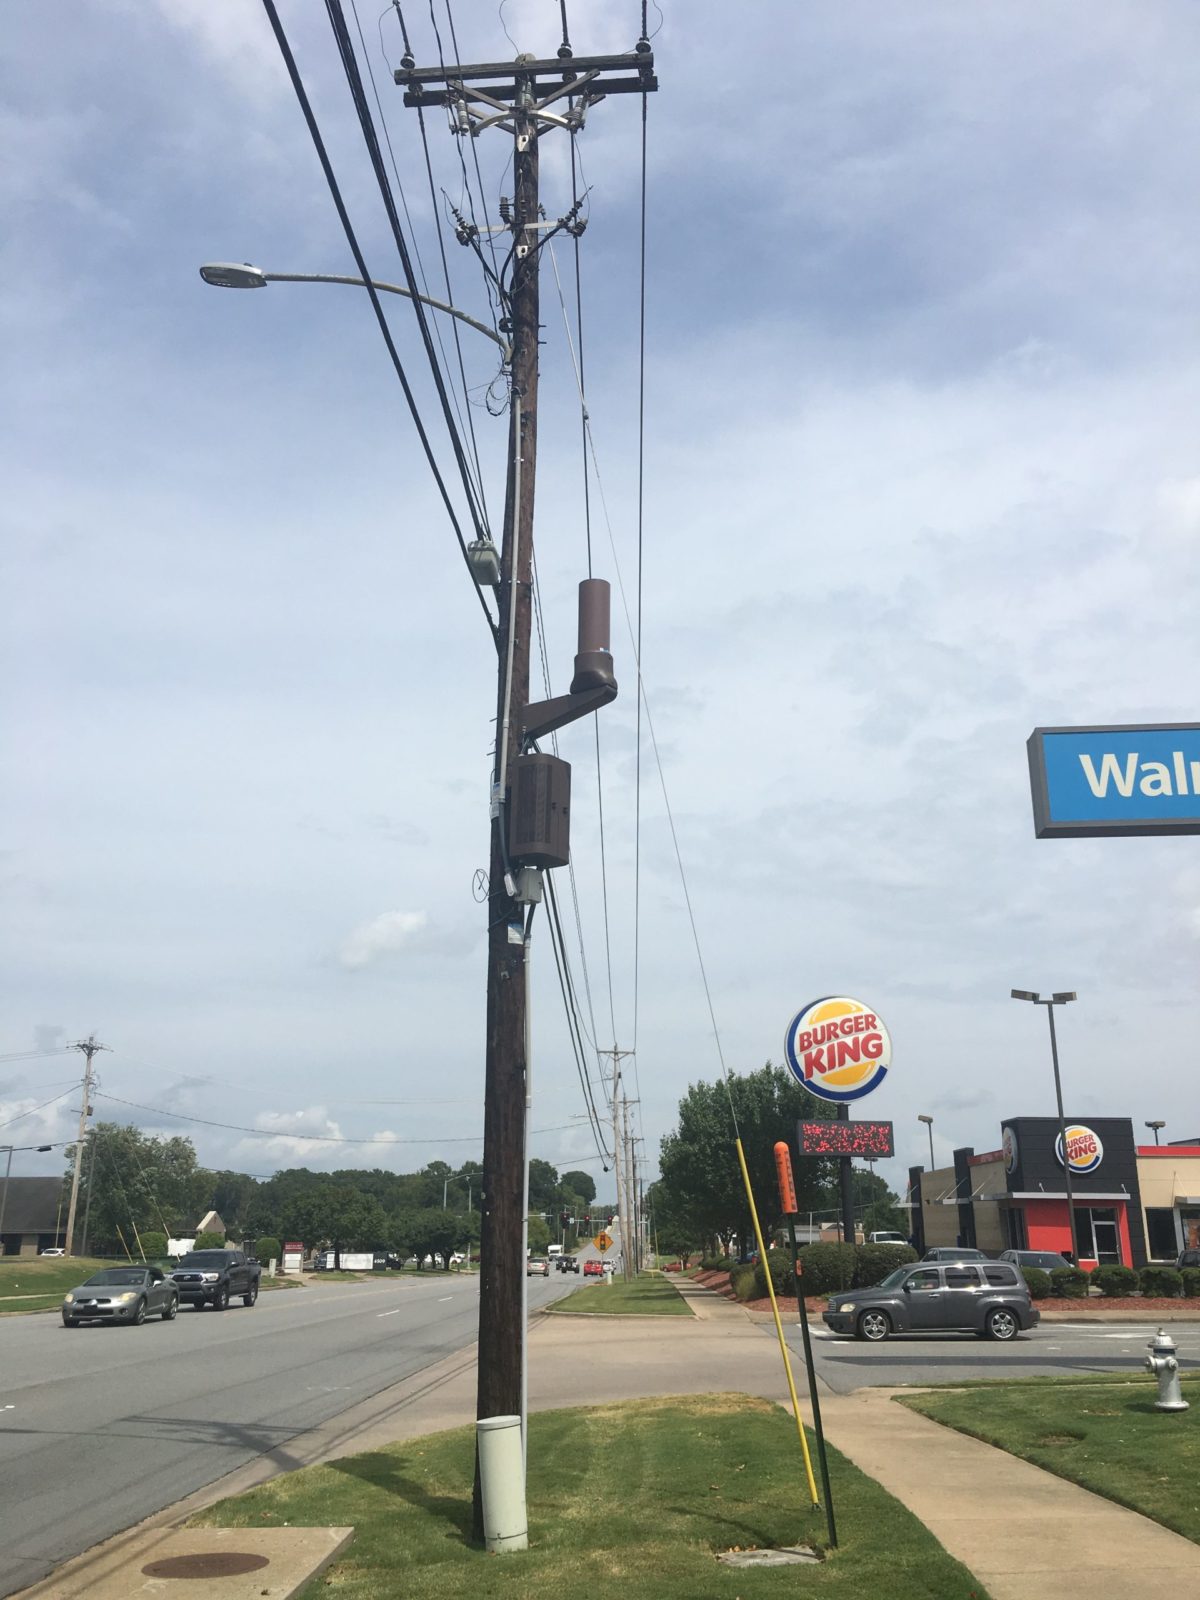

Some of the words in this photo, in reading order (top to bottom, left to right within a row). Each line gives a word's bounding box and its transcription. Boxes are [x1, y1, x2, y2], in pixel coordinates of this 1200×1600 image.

[1078, 751, 1200, 798] Wal
[799, 1013, 878, 1053] BURGER
[803, 1032, 883, 1080] KING
[1066, 1134, 1094, 1149] URGER
